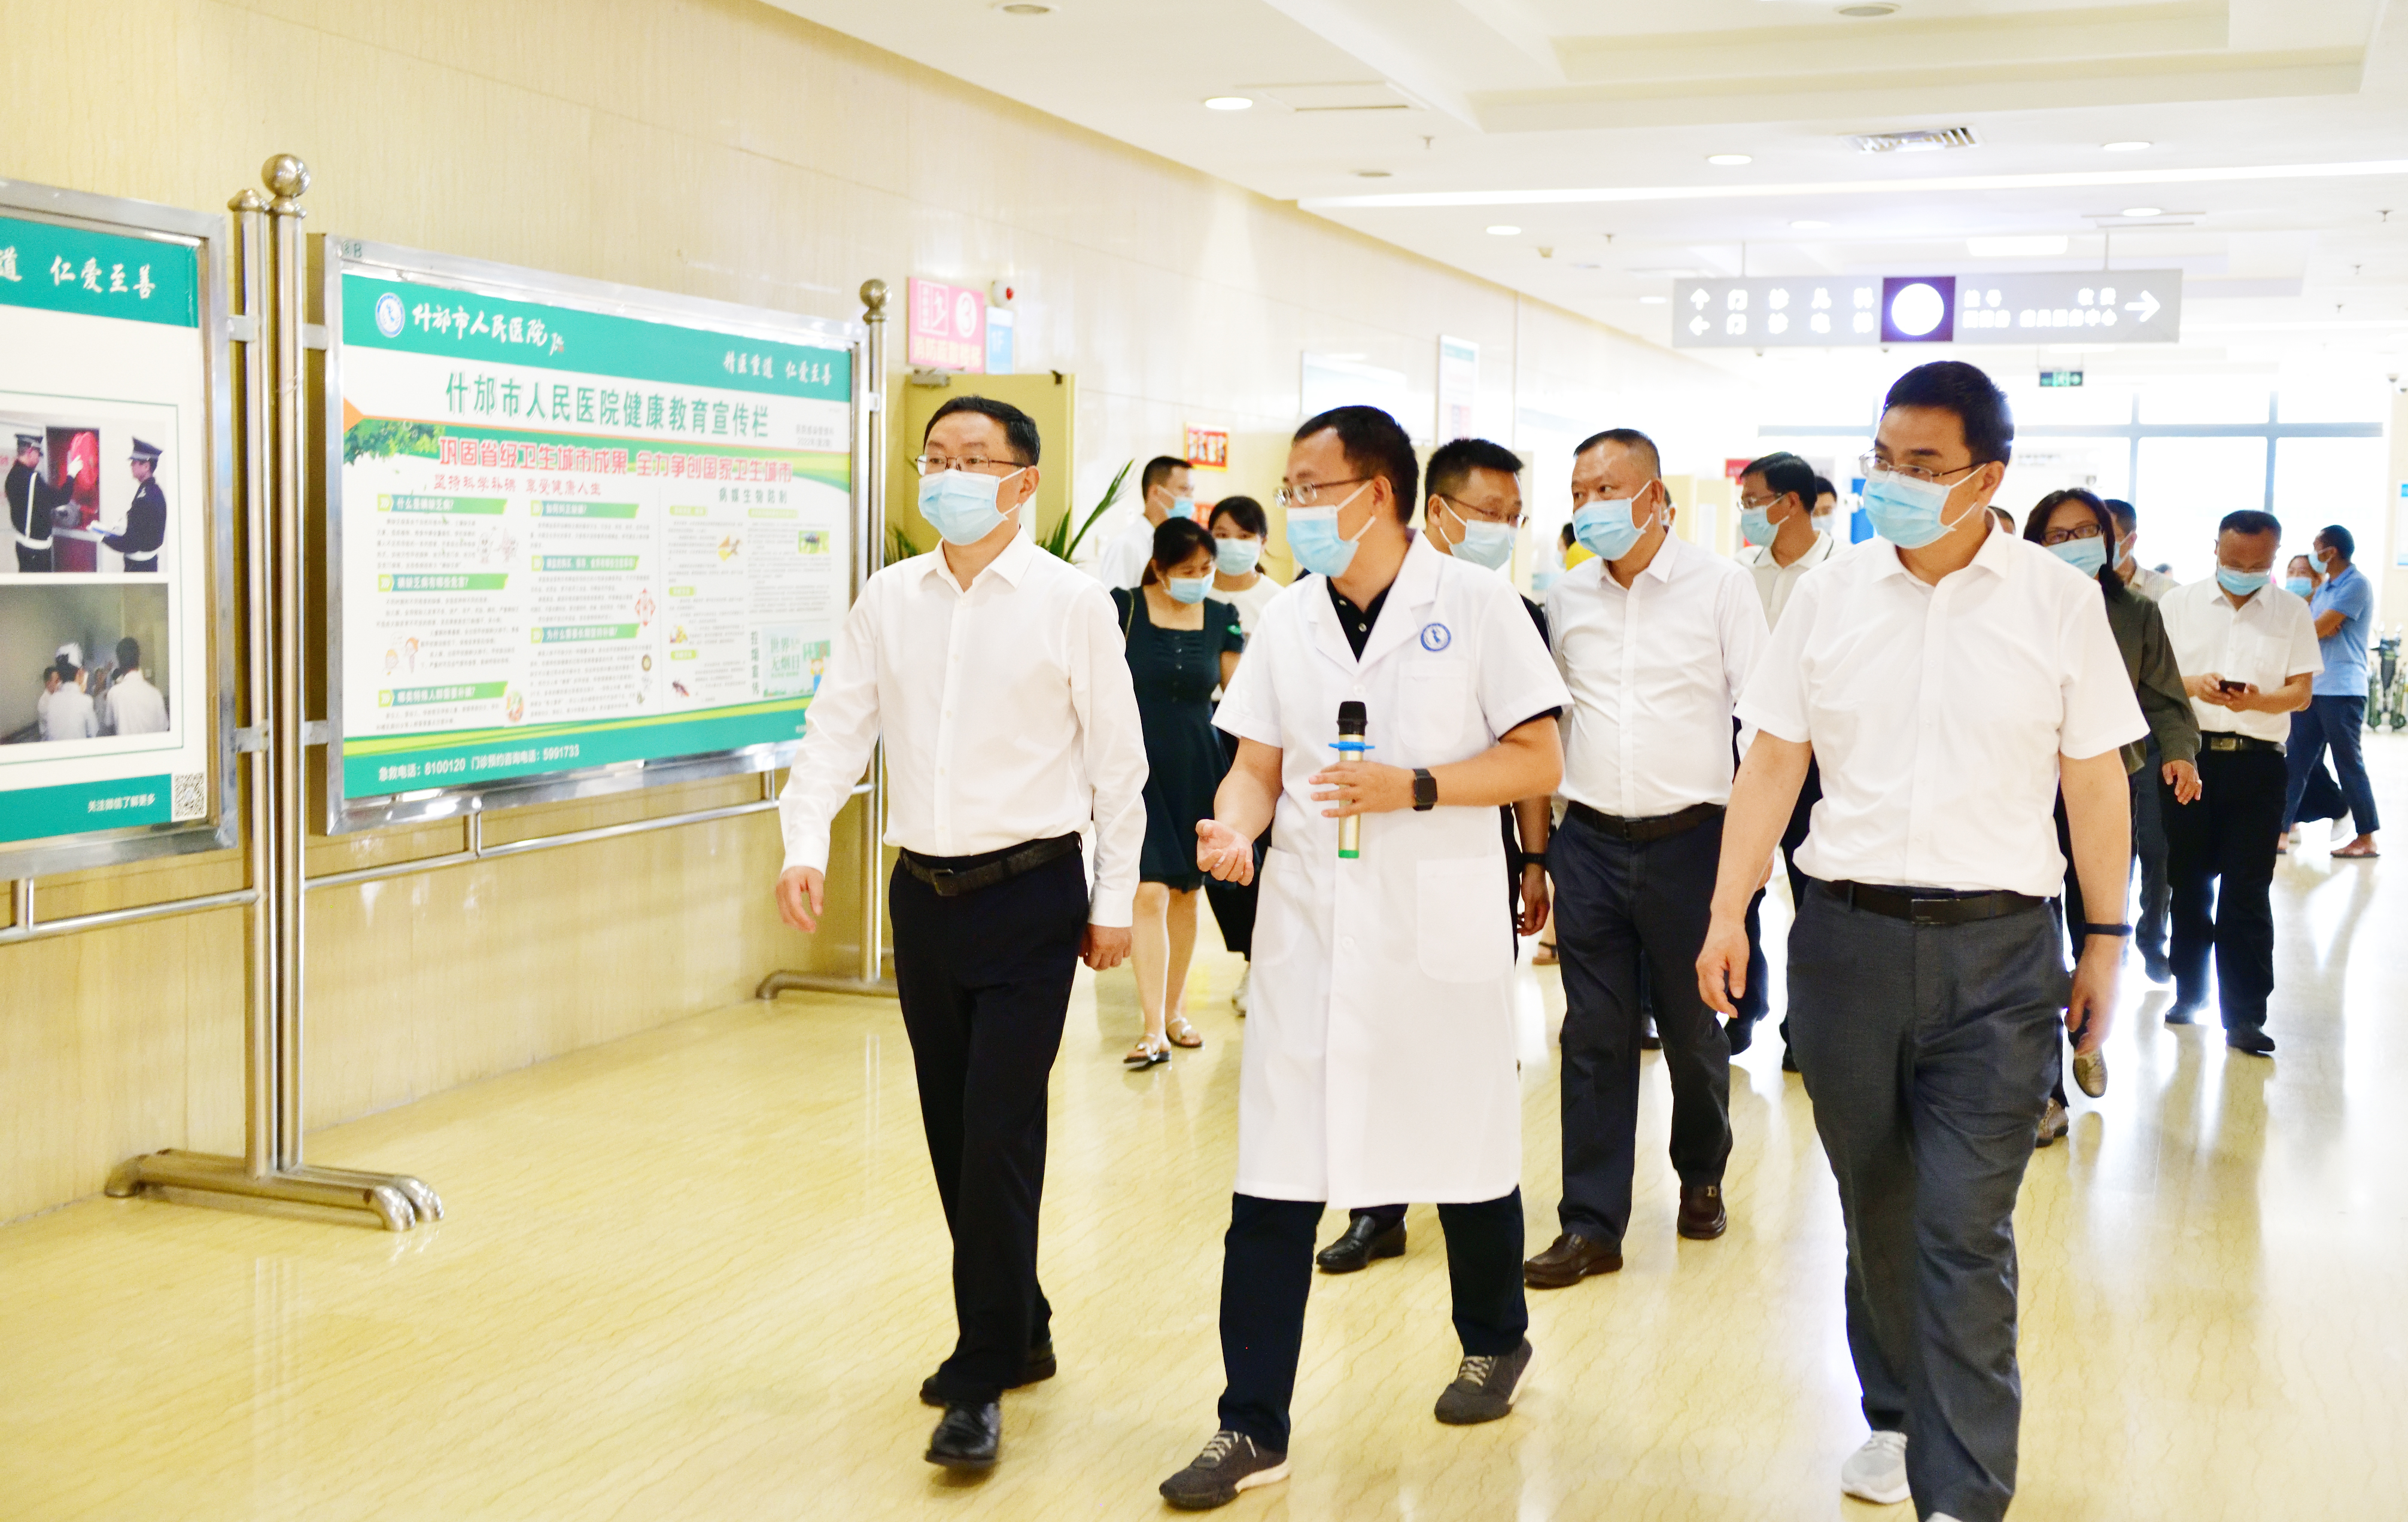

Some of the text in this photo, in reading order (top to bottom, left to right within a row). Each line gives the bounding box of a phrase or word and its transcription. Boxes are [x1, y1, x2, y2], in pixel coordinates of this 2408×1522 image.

[50, 255, 156, 299] 仁爱至善
[412, 302, 548, 348] 什邡市人民医院
[446, 372, 768, 438] 什邡市人民医院健康教育宣传栏
[439, 437, 793, 483] 巩固省级卫生城市成果 全力争创国家卫生城市
